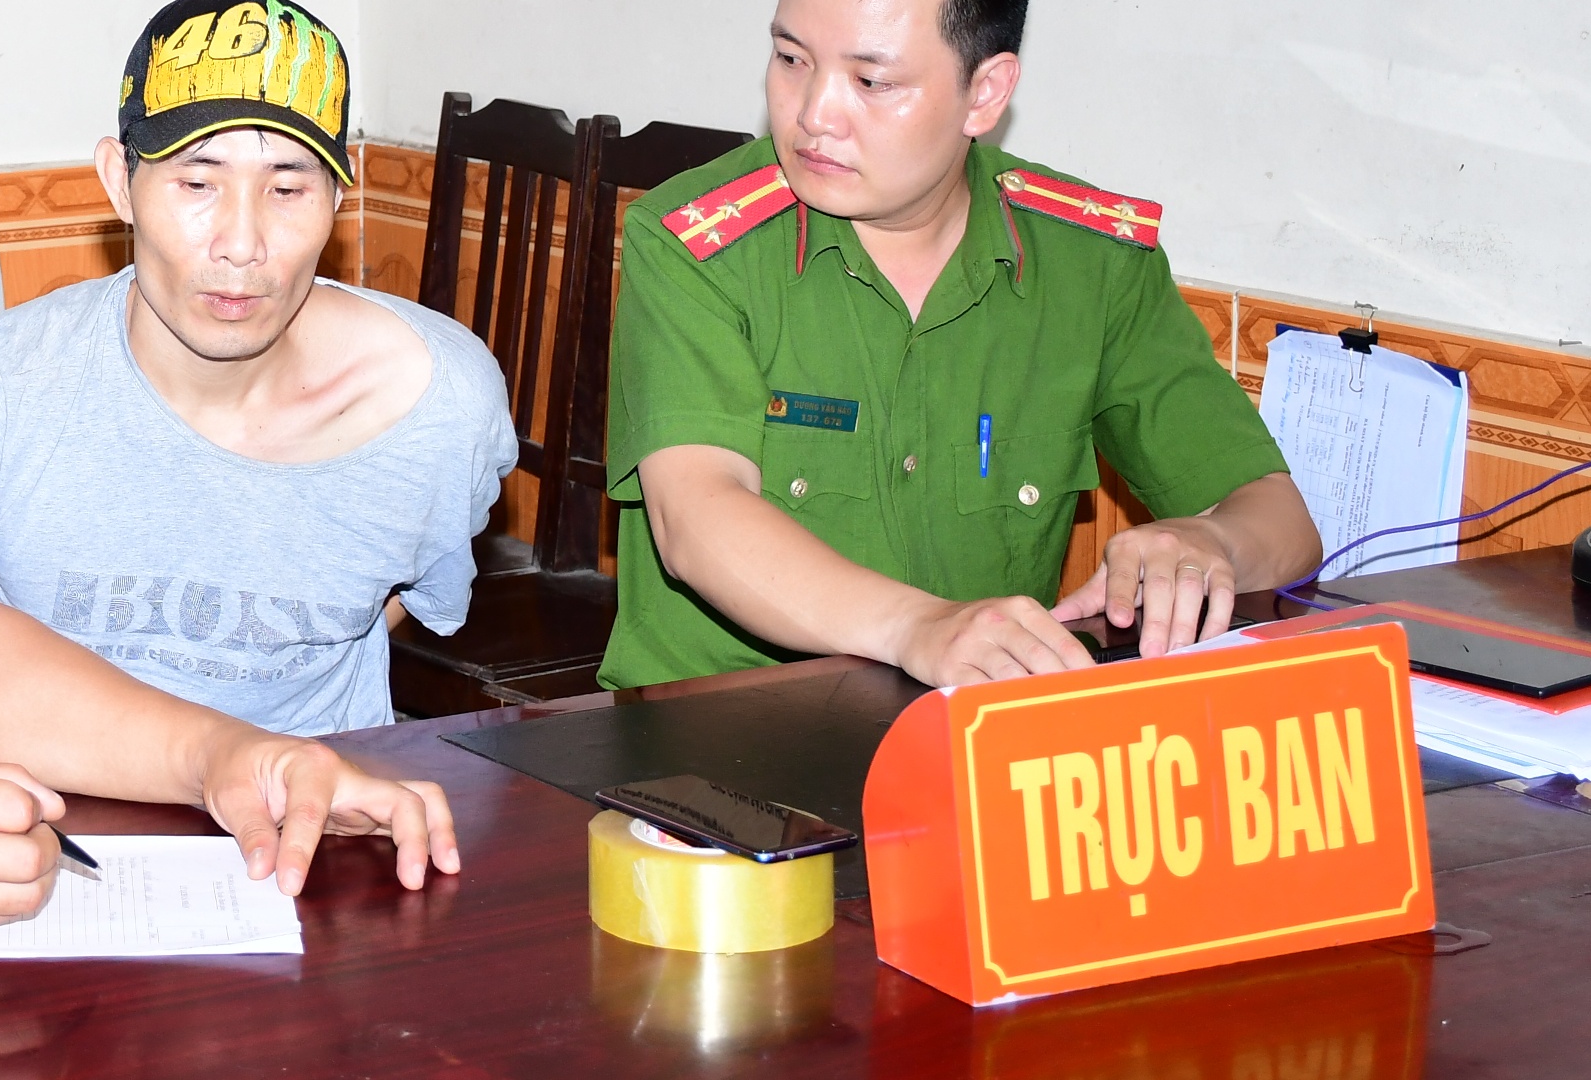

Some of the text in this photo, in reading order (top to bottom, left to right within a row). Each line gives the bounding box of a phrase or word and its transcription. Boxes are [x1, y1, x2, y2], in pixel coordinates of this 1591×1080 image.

[157, 2, 268, 70] 46
[1010, 707, 1375, 917] TRỰC BAN
